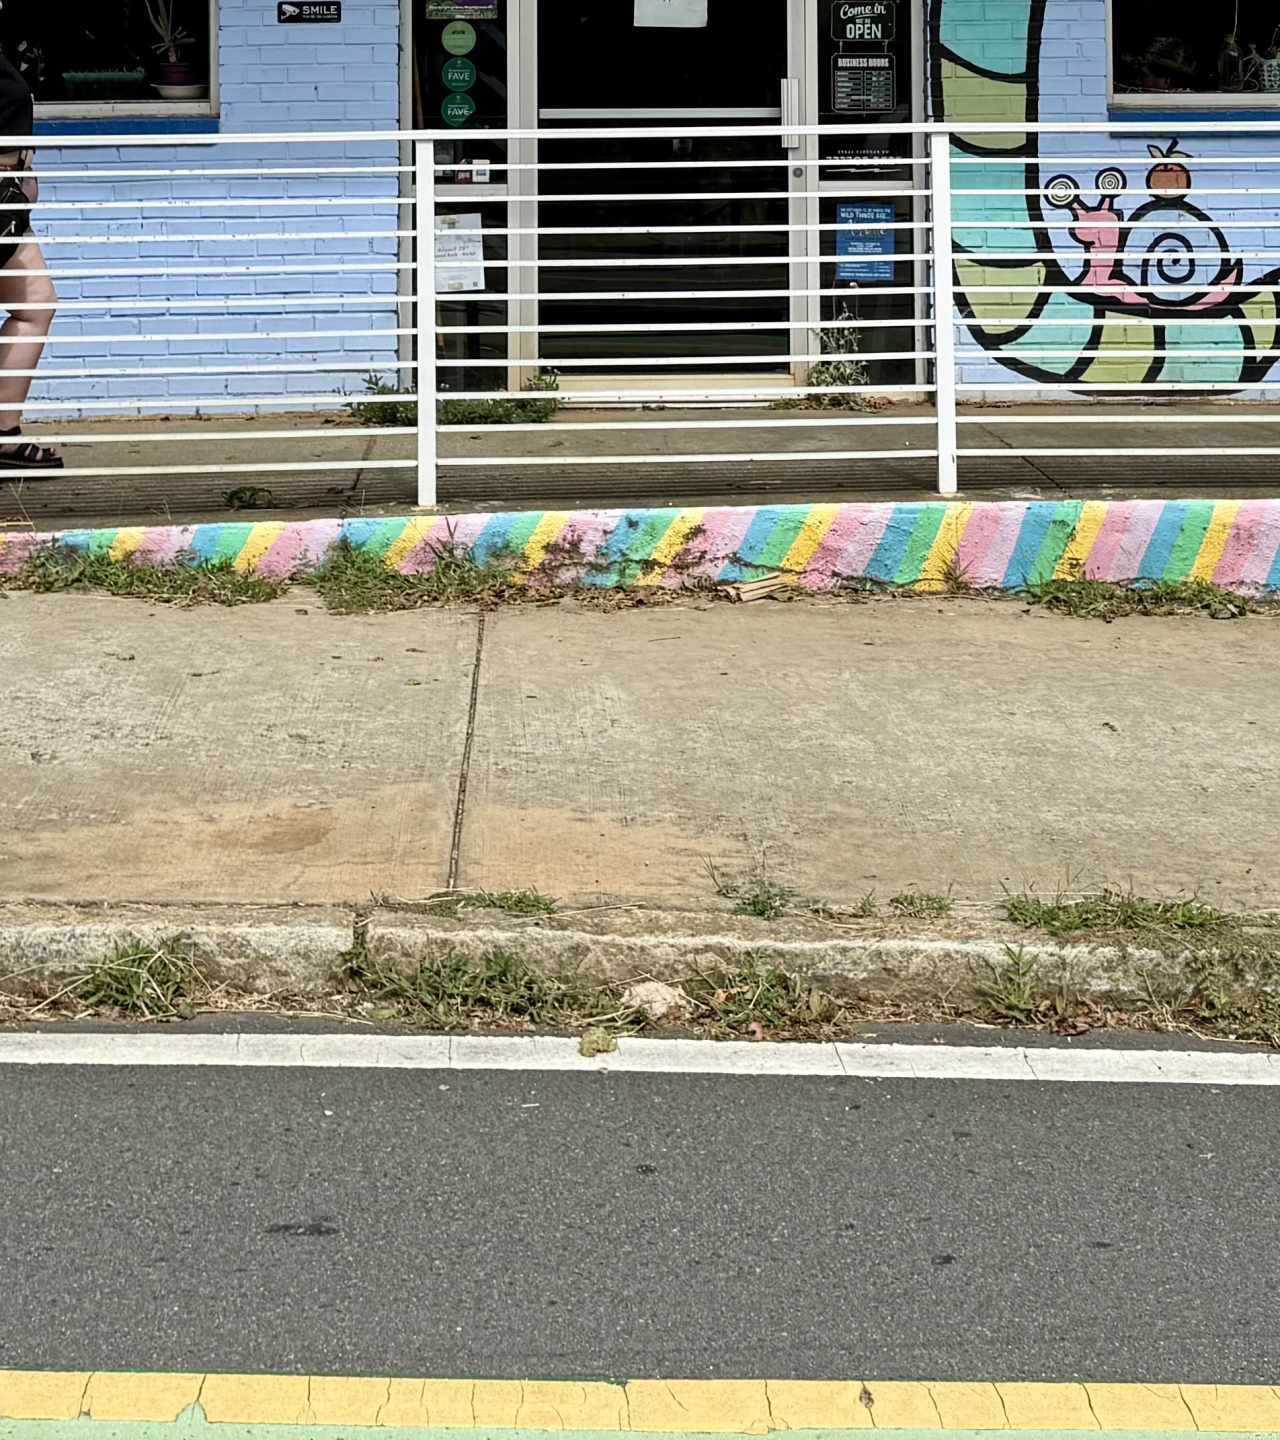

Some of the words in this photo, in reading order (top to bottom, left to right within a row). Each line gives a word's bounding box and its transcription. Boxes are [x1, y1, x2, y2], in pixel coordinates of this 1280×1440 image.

[302, 5, 338, 15] SMILE
[840, 4, 873, 19] Come
[874, 2, 887, 15] in
[846, 23, 882, 39] OPEN
[448, 72, 470, 81] FAVE
